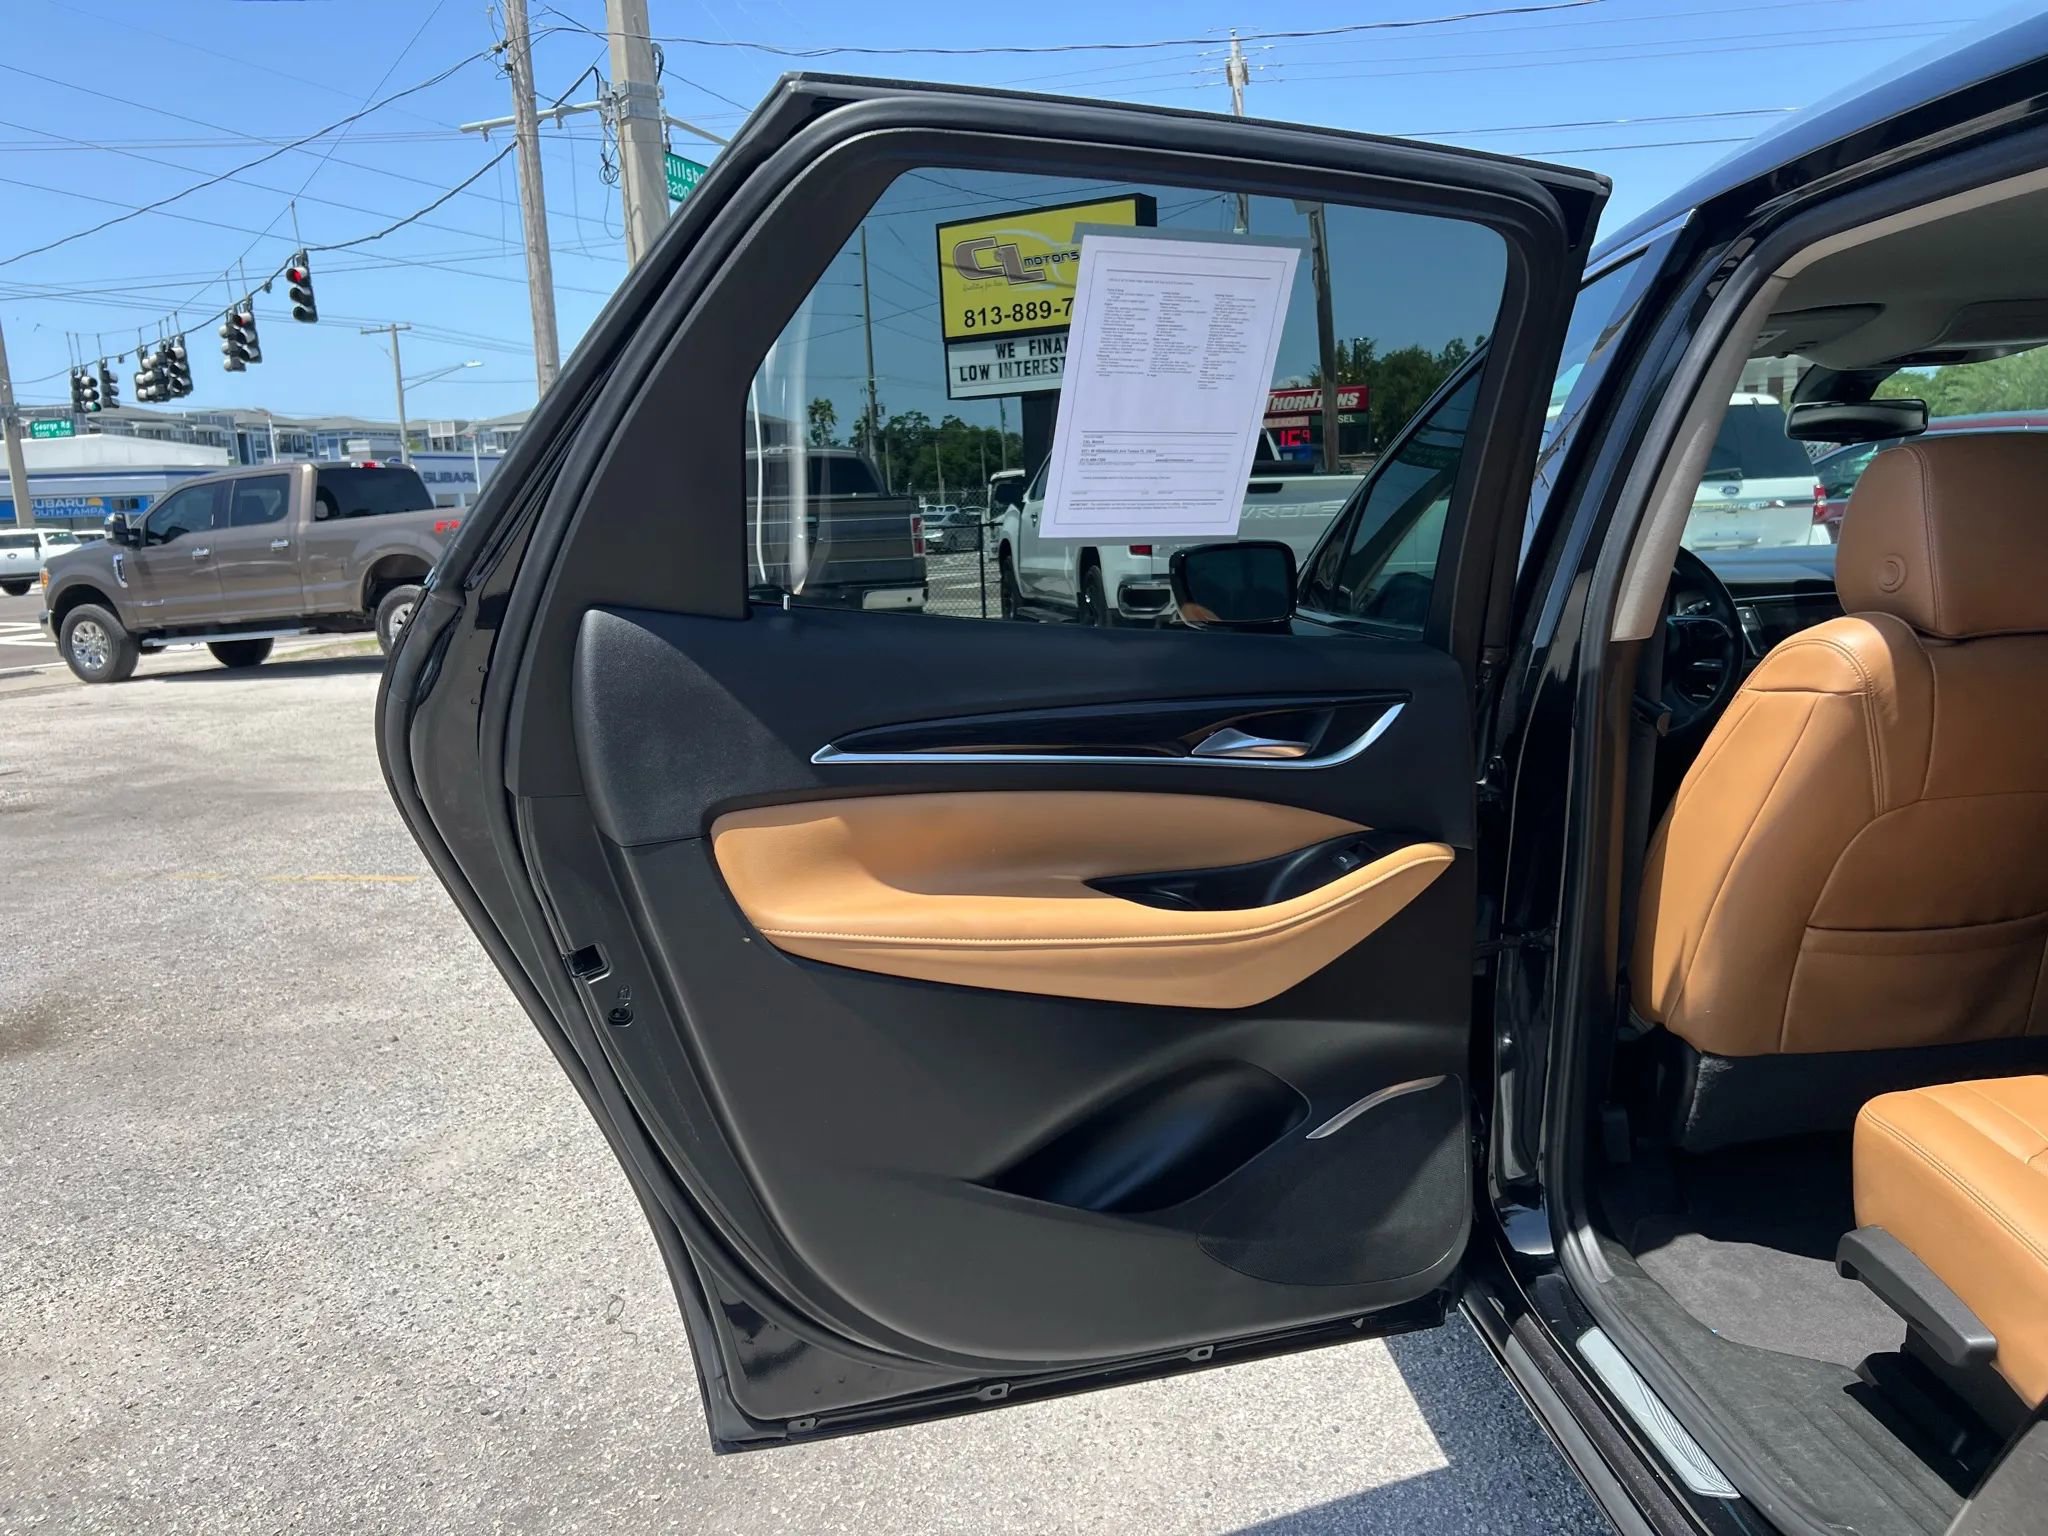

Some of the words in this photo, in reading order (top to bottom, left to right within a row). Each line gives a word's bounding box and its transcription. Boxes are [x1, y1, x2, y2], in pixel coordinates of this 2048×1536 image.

[964, 297, 1073, 328] 813-889-7
[996, 342, 1015, 359] WE
[960, 364, 989, 382] LOW
[33, 422, 57, 431] George
[60, 420, 71, 428] Rd
[32, 498, 86, 508] UBARU
[33, 508, 64, 516] OUTH
[67, 507, 105, 516] TAMPA
